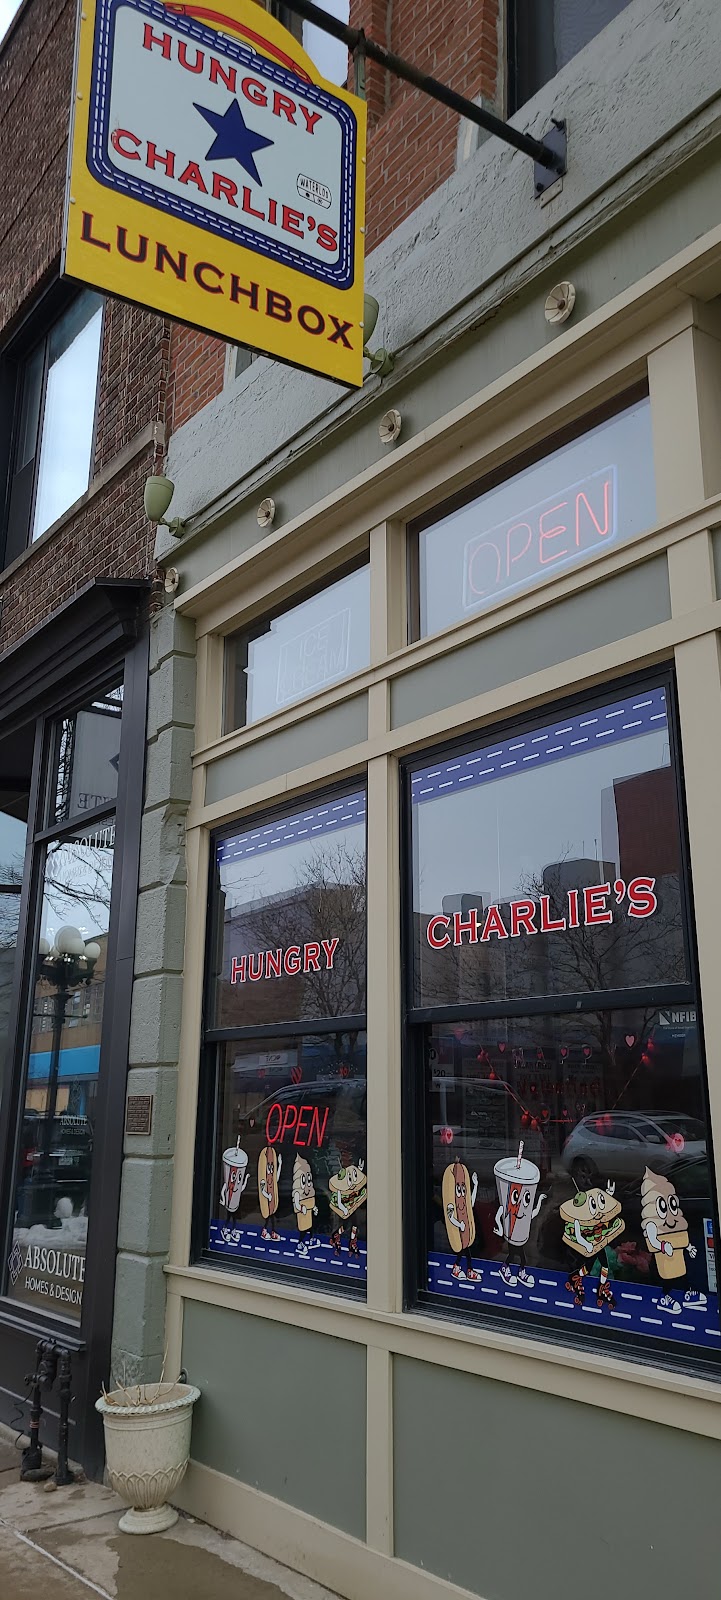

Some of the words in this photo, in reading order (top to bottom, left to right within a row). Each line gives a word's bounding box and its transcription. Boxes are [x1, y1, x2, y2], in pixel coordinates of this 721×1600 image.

[142, 22, 322, 135] HUNGRY
[111, 128, 338, 252] CHARLIE'S
[300, 178, 329, 199] WATERLOO
[80, 211, 354, 350] LUNCHBOX
[468, 481, 610, 595] OPEN
[427, 876, 658, 950] CHARLIE'S
[230, 937, 340, 984] HUNGRY
[671, 1011, 697, 1023] NFIB
[265, 1103, 329, 1148] OPEN
[23, 1244, 86, 1283] ABSOLUTE
[24, 1276, 49, 1295] HOMES
[49, 1283, 55, 1297] &
[55, 1284, 83, 1305] DESIGN
